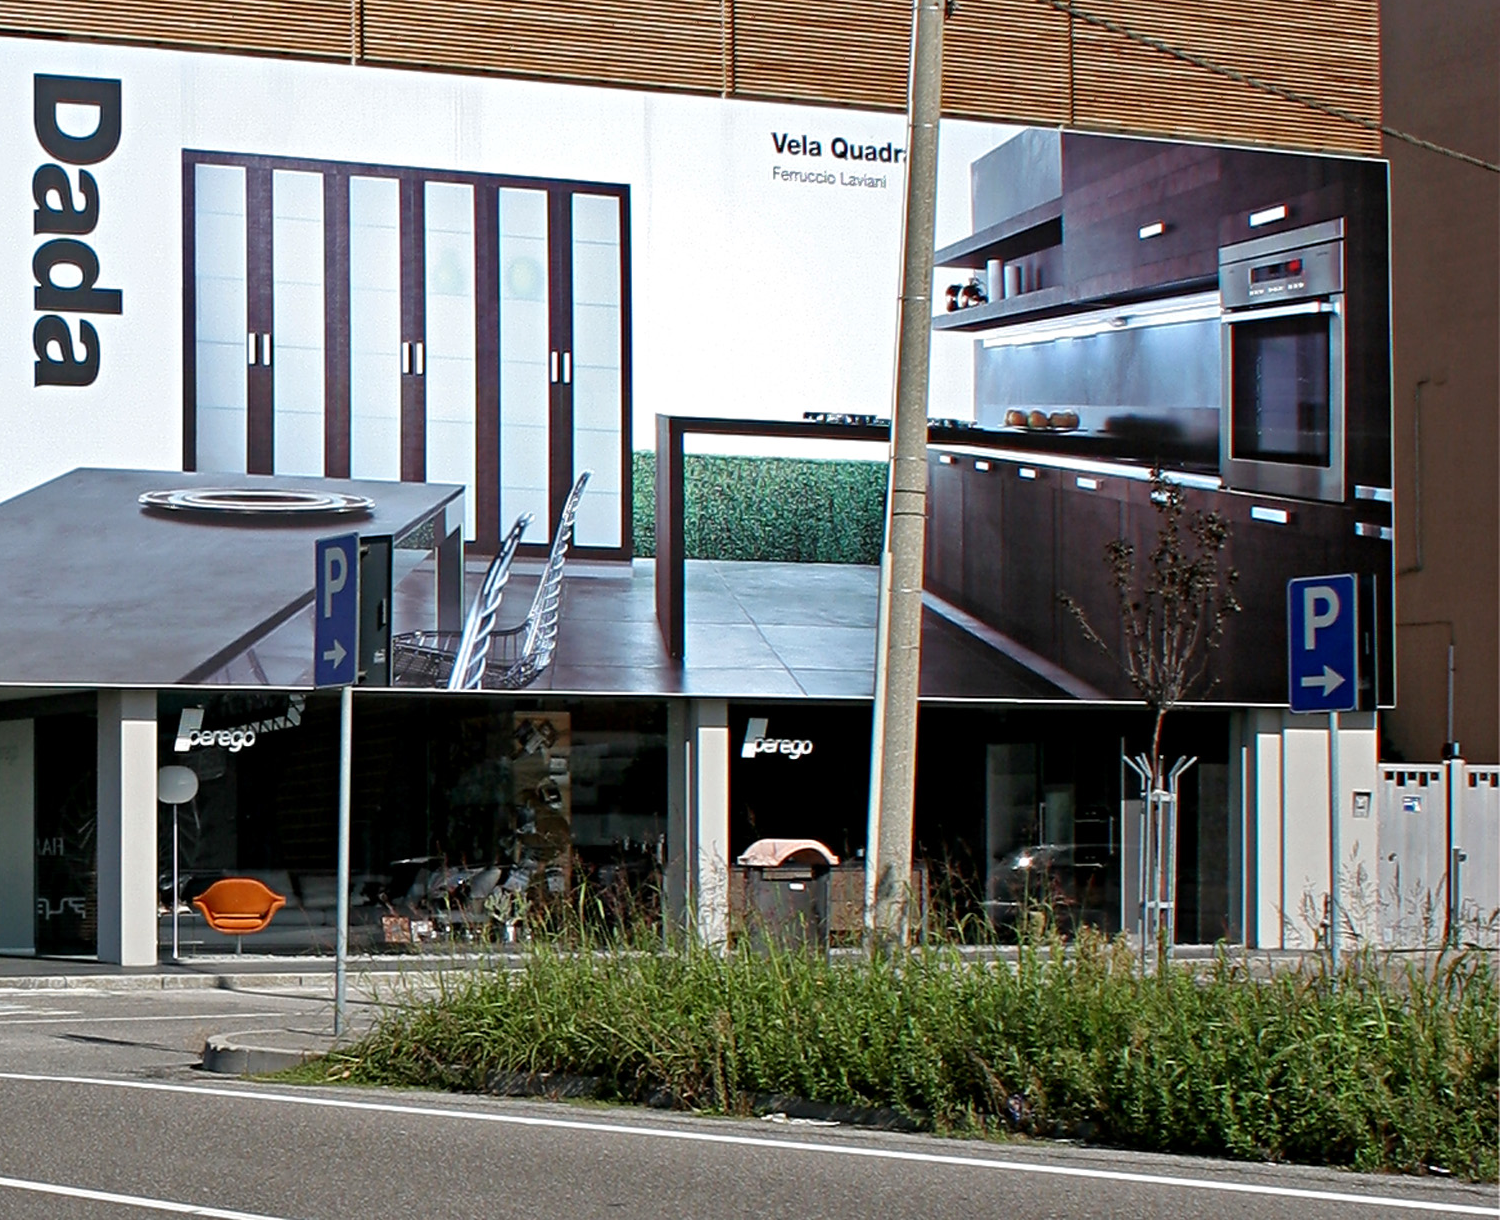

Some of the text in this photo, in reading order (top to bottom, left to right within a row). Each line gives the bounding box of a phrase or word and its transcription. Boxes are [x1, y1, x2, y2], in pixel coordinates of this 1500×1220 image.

[771, 132, 907, 163] Vela Quadr
[773, 166, 887, 189] Ferruccio Laviani
[33, 73, 122, 388] Dada
[323, 546, 349, 618] P
[1303, 586, 1339, 650] P
